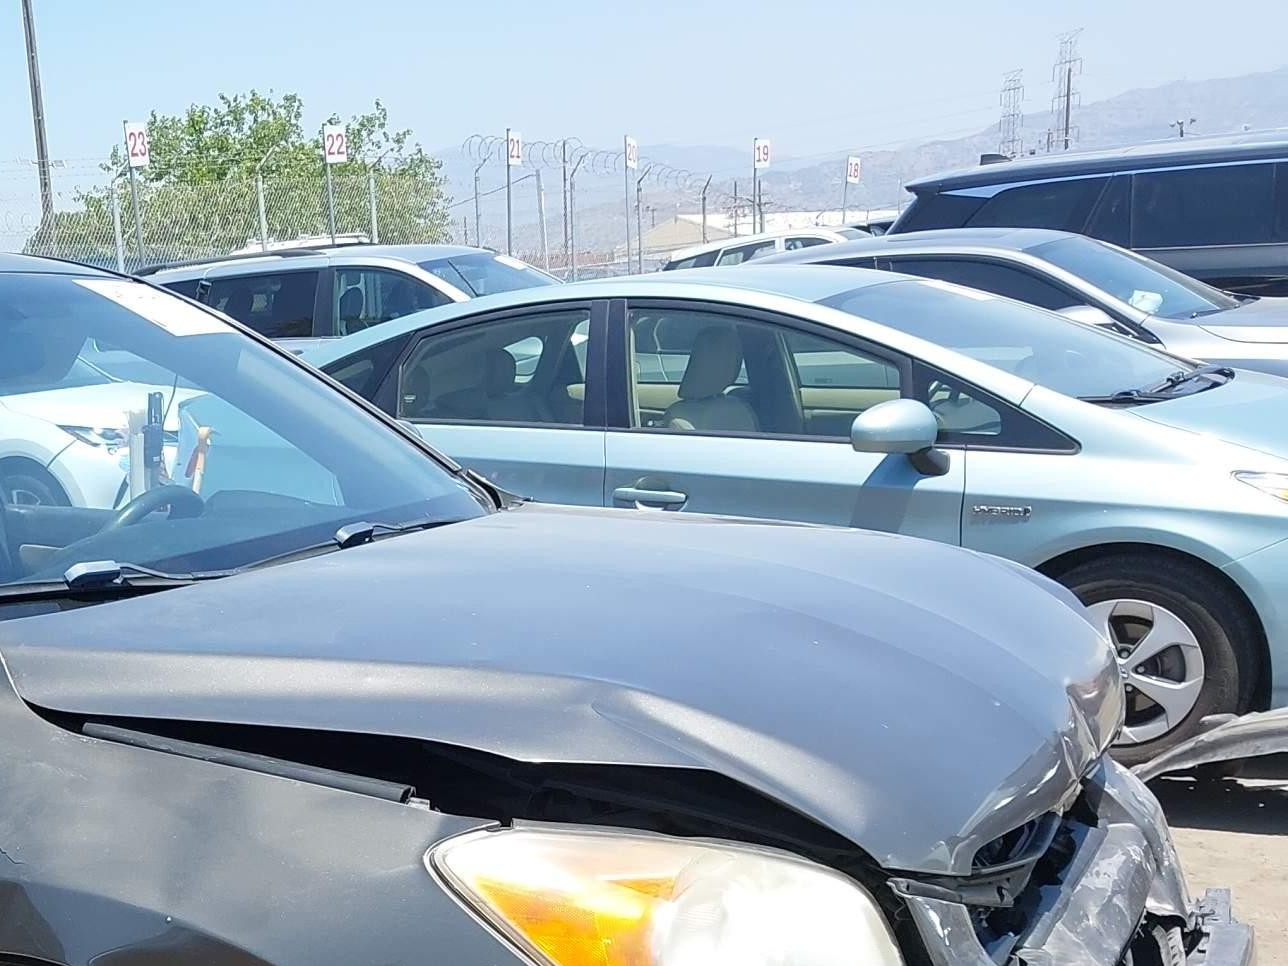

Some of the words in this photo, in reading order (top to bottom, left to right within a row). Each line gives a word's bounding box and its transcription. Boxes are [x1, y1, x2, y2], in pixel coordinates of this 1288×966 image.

[128, 131, 147, 157] 23
[326, 133, 345, 156] 22
[509, 138, 521, 158] 21
[756, 145, 769, 162] 19
[848, 162, 859, 178] 18
